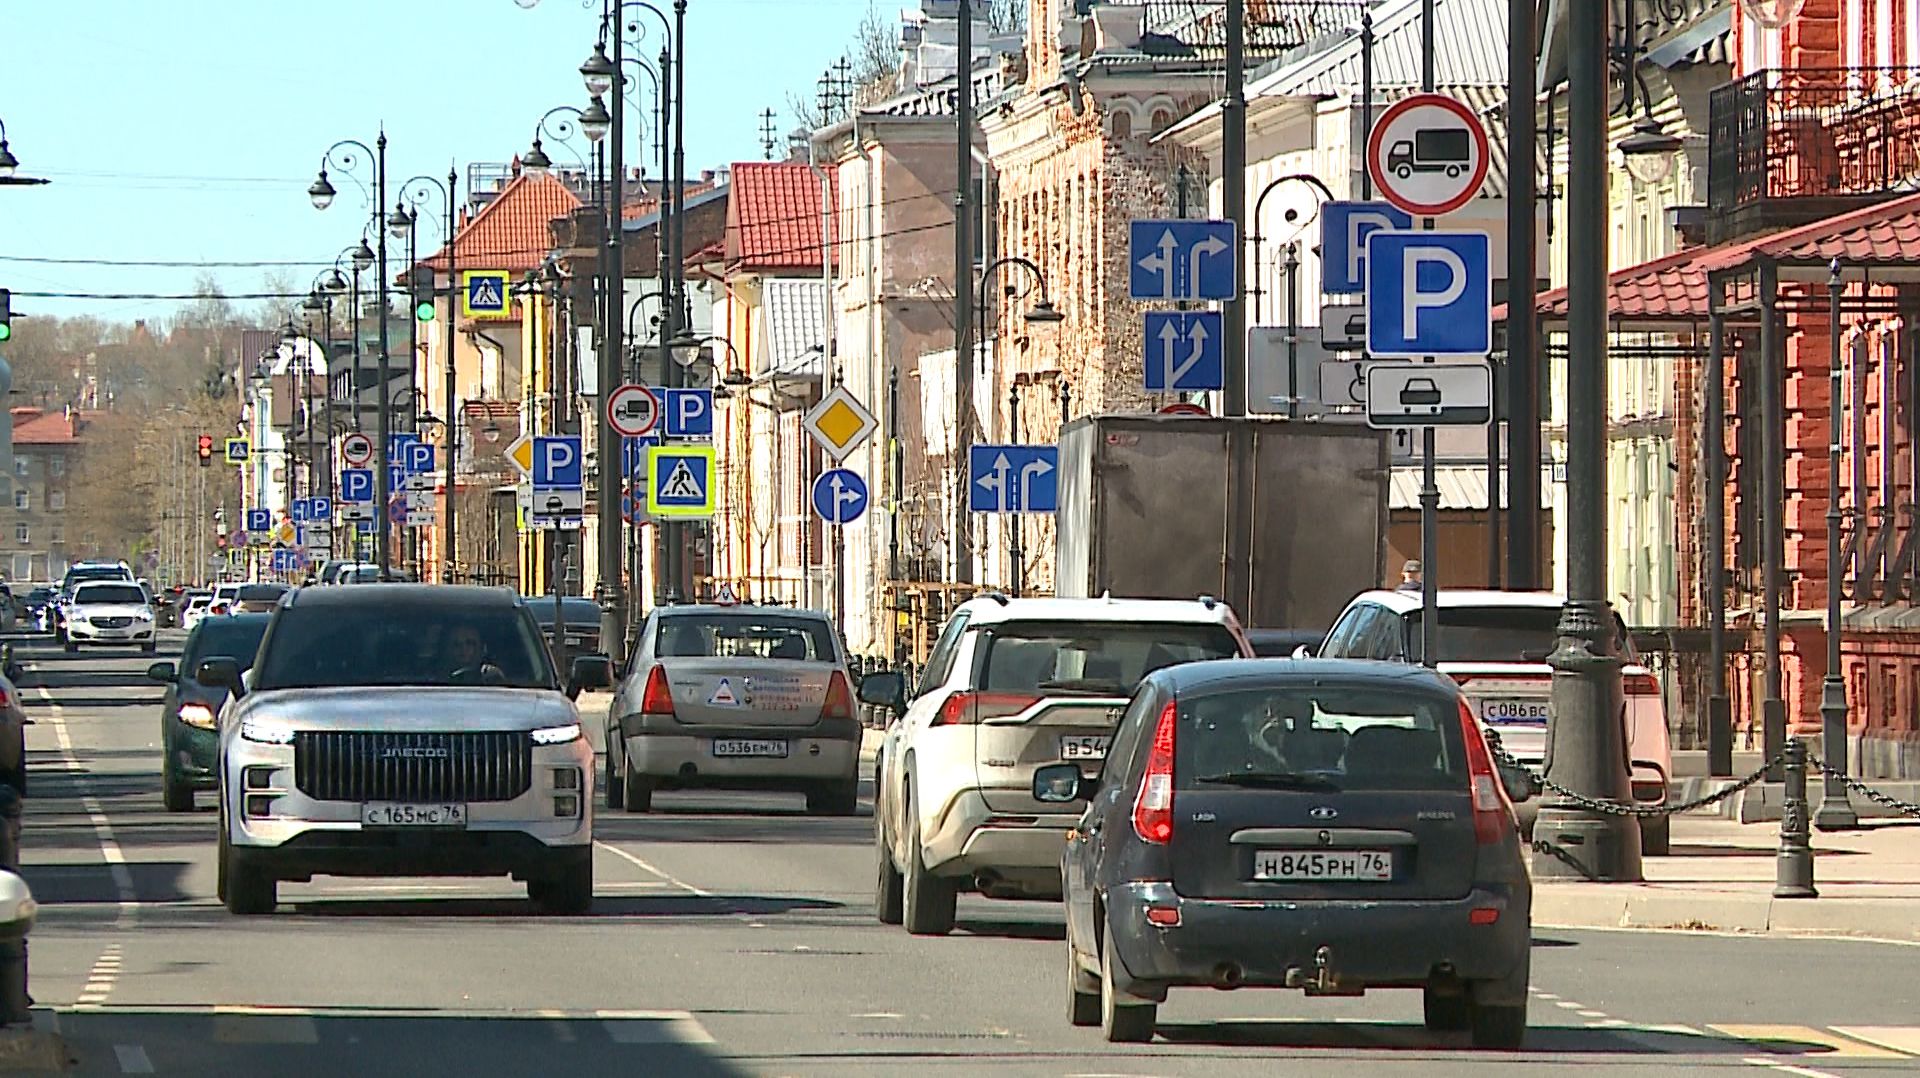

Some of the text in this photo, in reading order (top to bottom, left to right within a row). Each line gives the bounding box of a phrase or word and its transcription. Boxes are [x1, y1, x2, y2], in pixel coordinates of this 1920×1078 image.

[1403, 246, 1467, 340] P
[679, 394, 704, 430] P
[413, 447, 429, 469] P
[546, 442, 573, 481] P
[350, 473, 367, 497] P
[314, 499, 327, 517] P
[253, 512, 267, 529] P
[1067, 738, 1105, 755] В54
[443, 806, 460, 819] 76
[1362, 854, 1383, 871] 76
